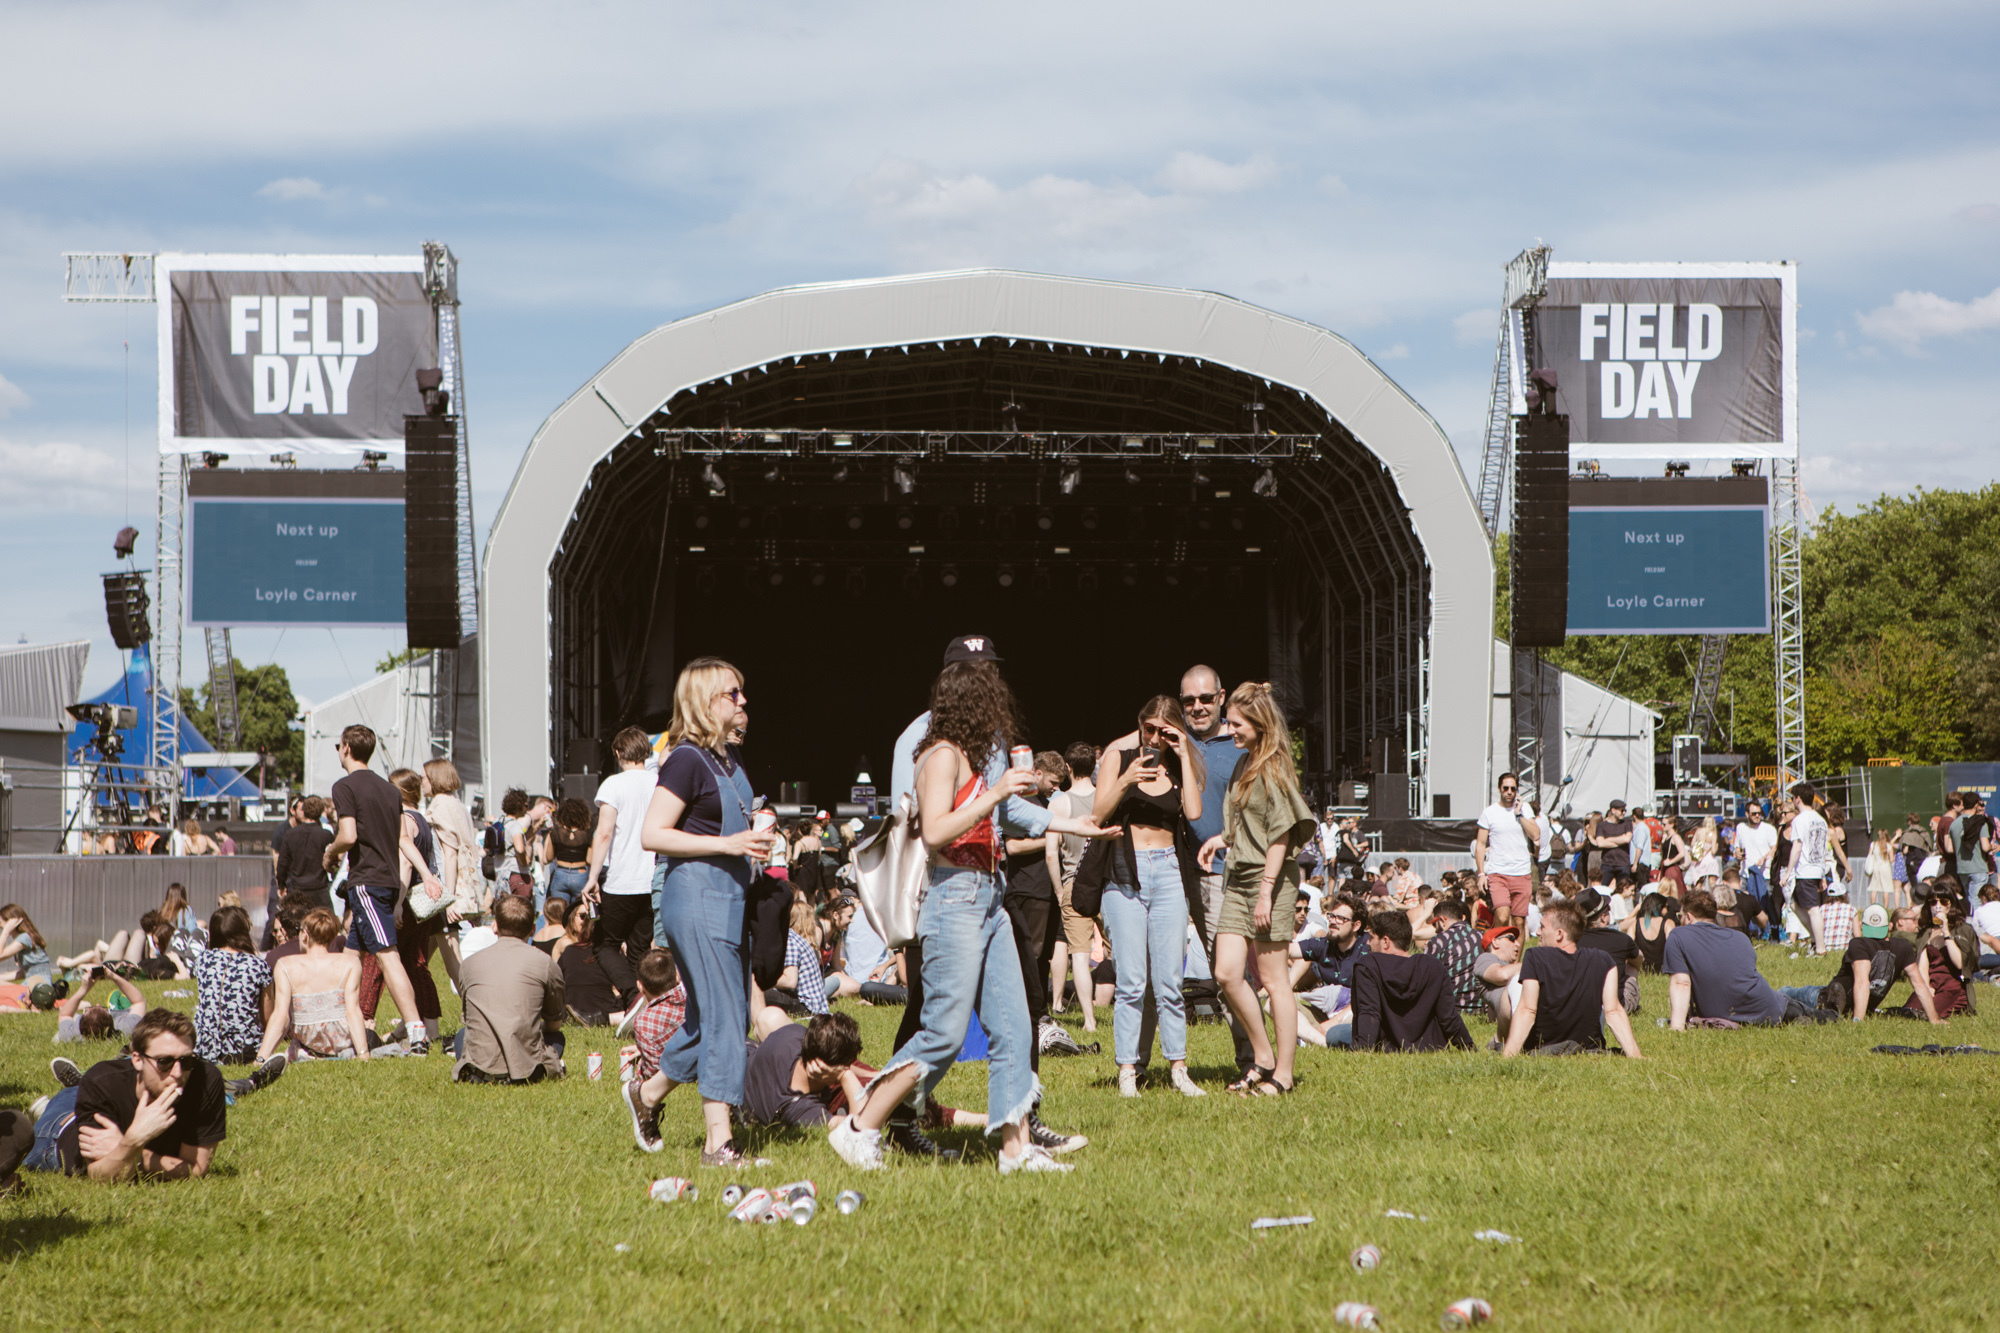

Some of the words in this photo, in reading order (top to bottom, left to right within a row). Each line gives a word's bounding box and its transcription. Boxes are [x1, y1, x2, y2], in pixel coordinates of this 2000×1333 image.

[231, 296, 379, 356] FIELD
[1580, 303, 1723, 361] FIELD
[253, 355, 358, 415] DAY
[1601, 361, 1702, 419] DAY
[276, 523, 314, 536] Next
[319, 526, 339, 539] up
[1625, 531, 1660, 544] Next
[1666, 533, 1685, 546] up
[256, 587, 298, 604] Loyle
[303, 587, 357, 601] Carner
[1607, 595, 1648, 610] Loyle
[1653, 594, 1705, 607] Carner
[963, 638, 985, 651] W
